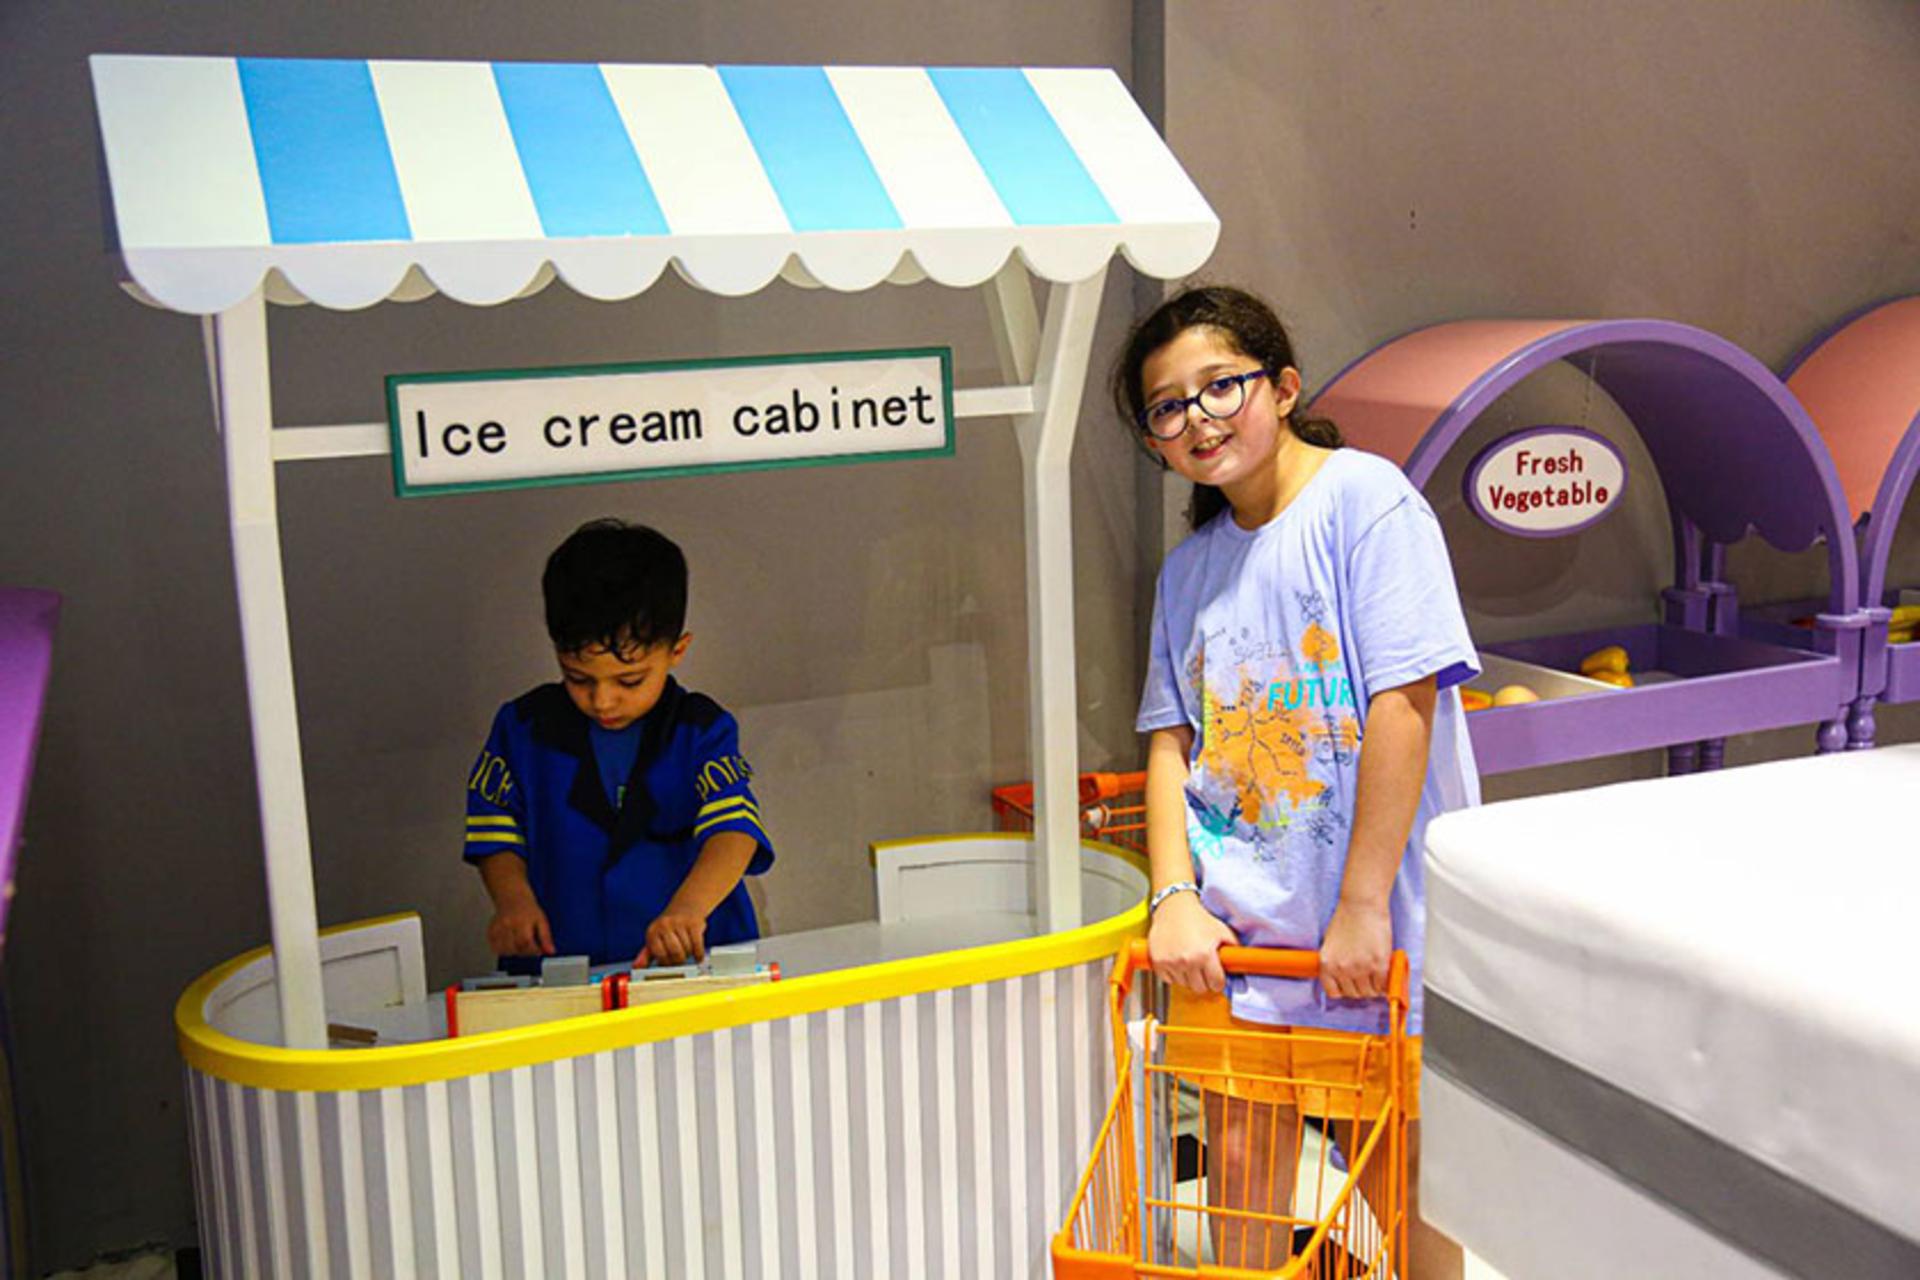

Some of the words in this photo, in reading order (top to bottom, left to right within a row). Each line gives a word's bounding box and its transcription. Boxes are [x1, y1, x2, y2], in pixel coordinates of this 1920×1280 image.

[416, 410, 508, 458] Ice
[542, 405, 704, 449] cream
[732, 385, 937, 437] cabinet
[1515, 448, 1584, 476] Fresh
[1488, 480, 1609, 513] Vegetable
